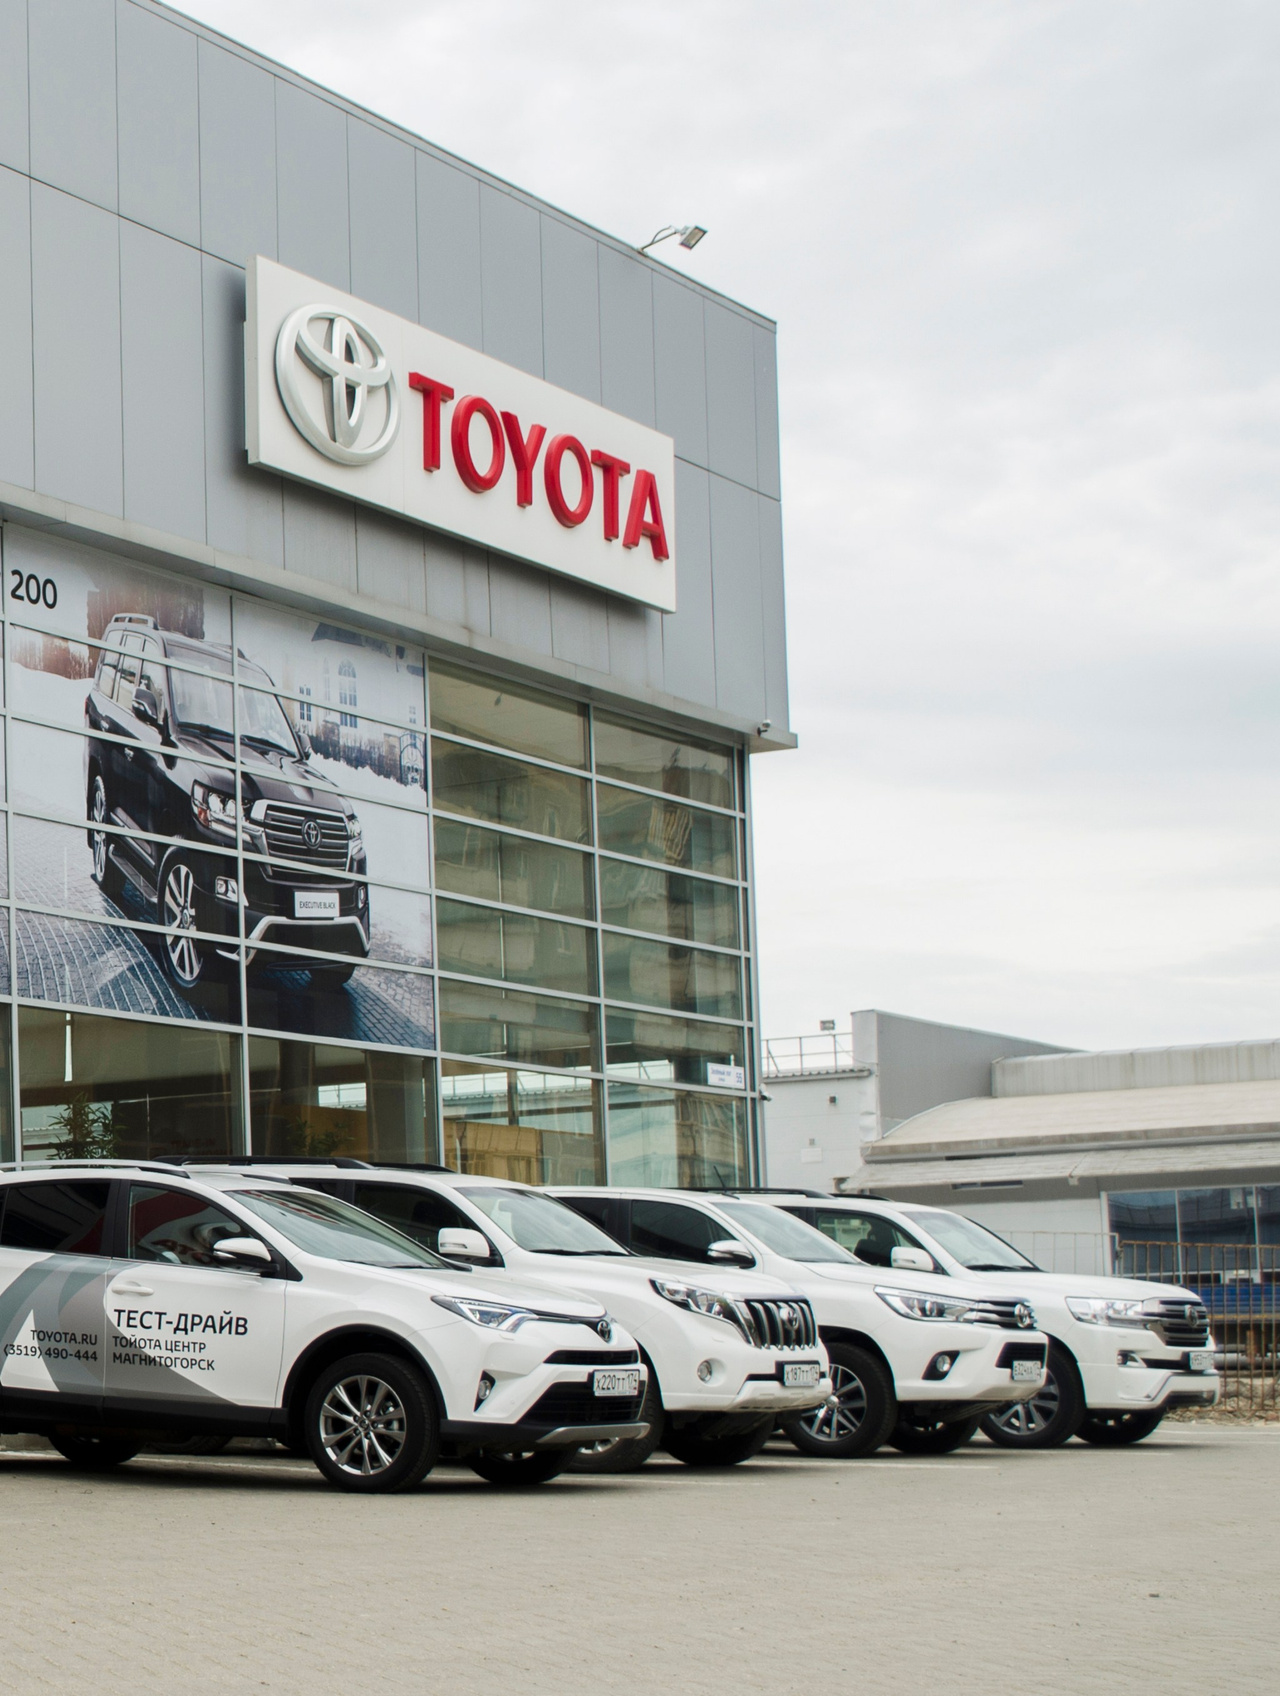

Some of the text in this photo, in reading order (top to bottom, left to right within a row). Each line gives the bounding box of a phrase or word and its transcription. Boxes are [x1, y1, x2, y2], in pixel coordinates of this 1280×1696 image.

[408, 371, 670, 562] TOYOTA
[10, 569, 58, 609] 200
[113, 1308, 249, 1336] ТЕСТ-ДРАЙВ
[30, 1329, 98, 1346] TOYOTA.RU
[112, 1334, 206, 1354] ТОЙОТА ЦЕНТР
[3, 1343, 98, 1362] (3519) 490-444
[112, 1352, 216, 1371] МАГНИТОГОРСК
